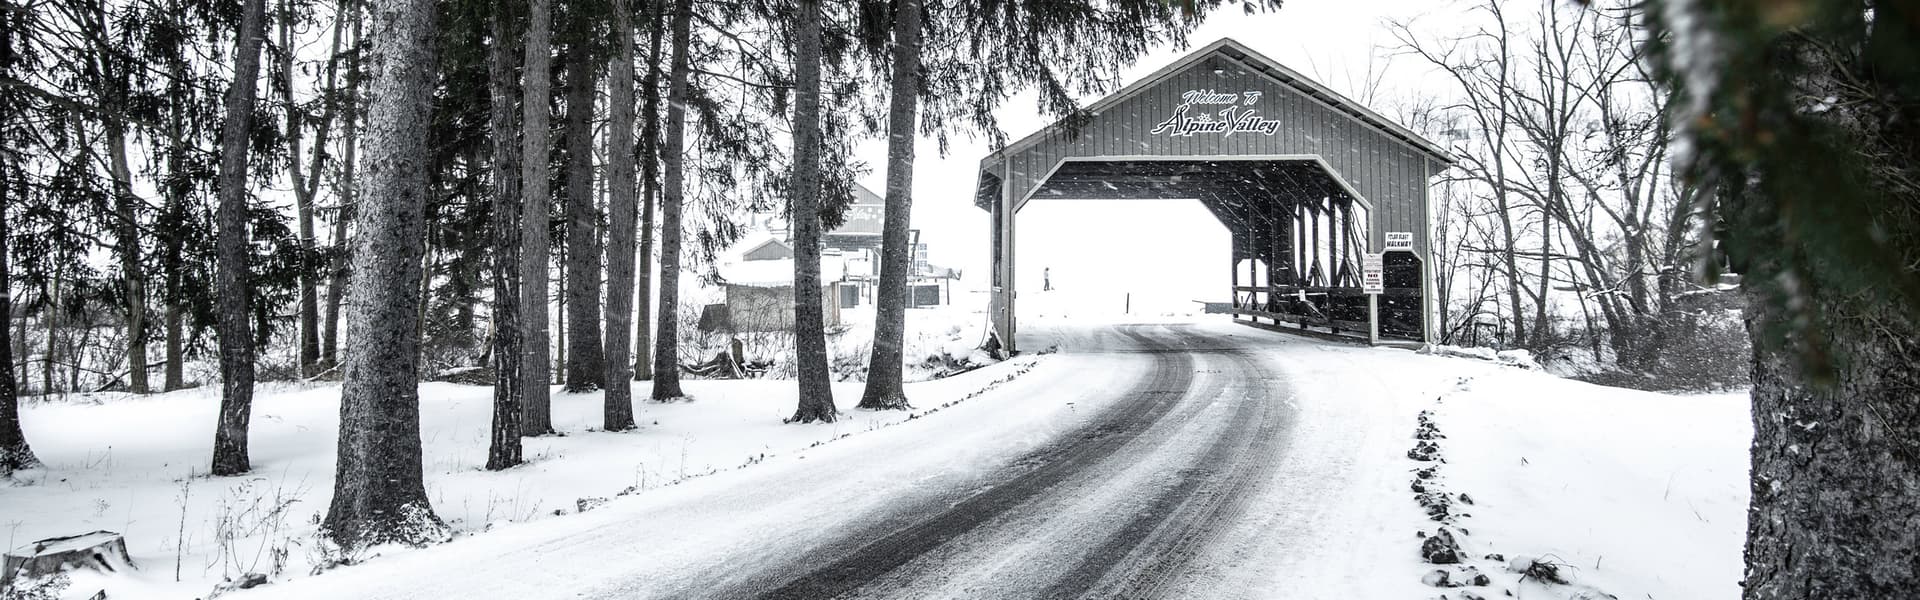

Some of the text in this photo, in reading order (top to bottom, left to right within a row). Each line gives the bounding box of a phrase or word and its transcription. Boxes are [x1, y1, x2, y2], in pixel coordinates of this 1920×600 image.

[1182, 89, 1262, 105] Welcome To
[1151, 104, 1280, 137] Alpine Valley
